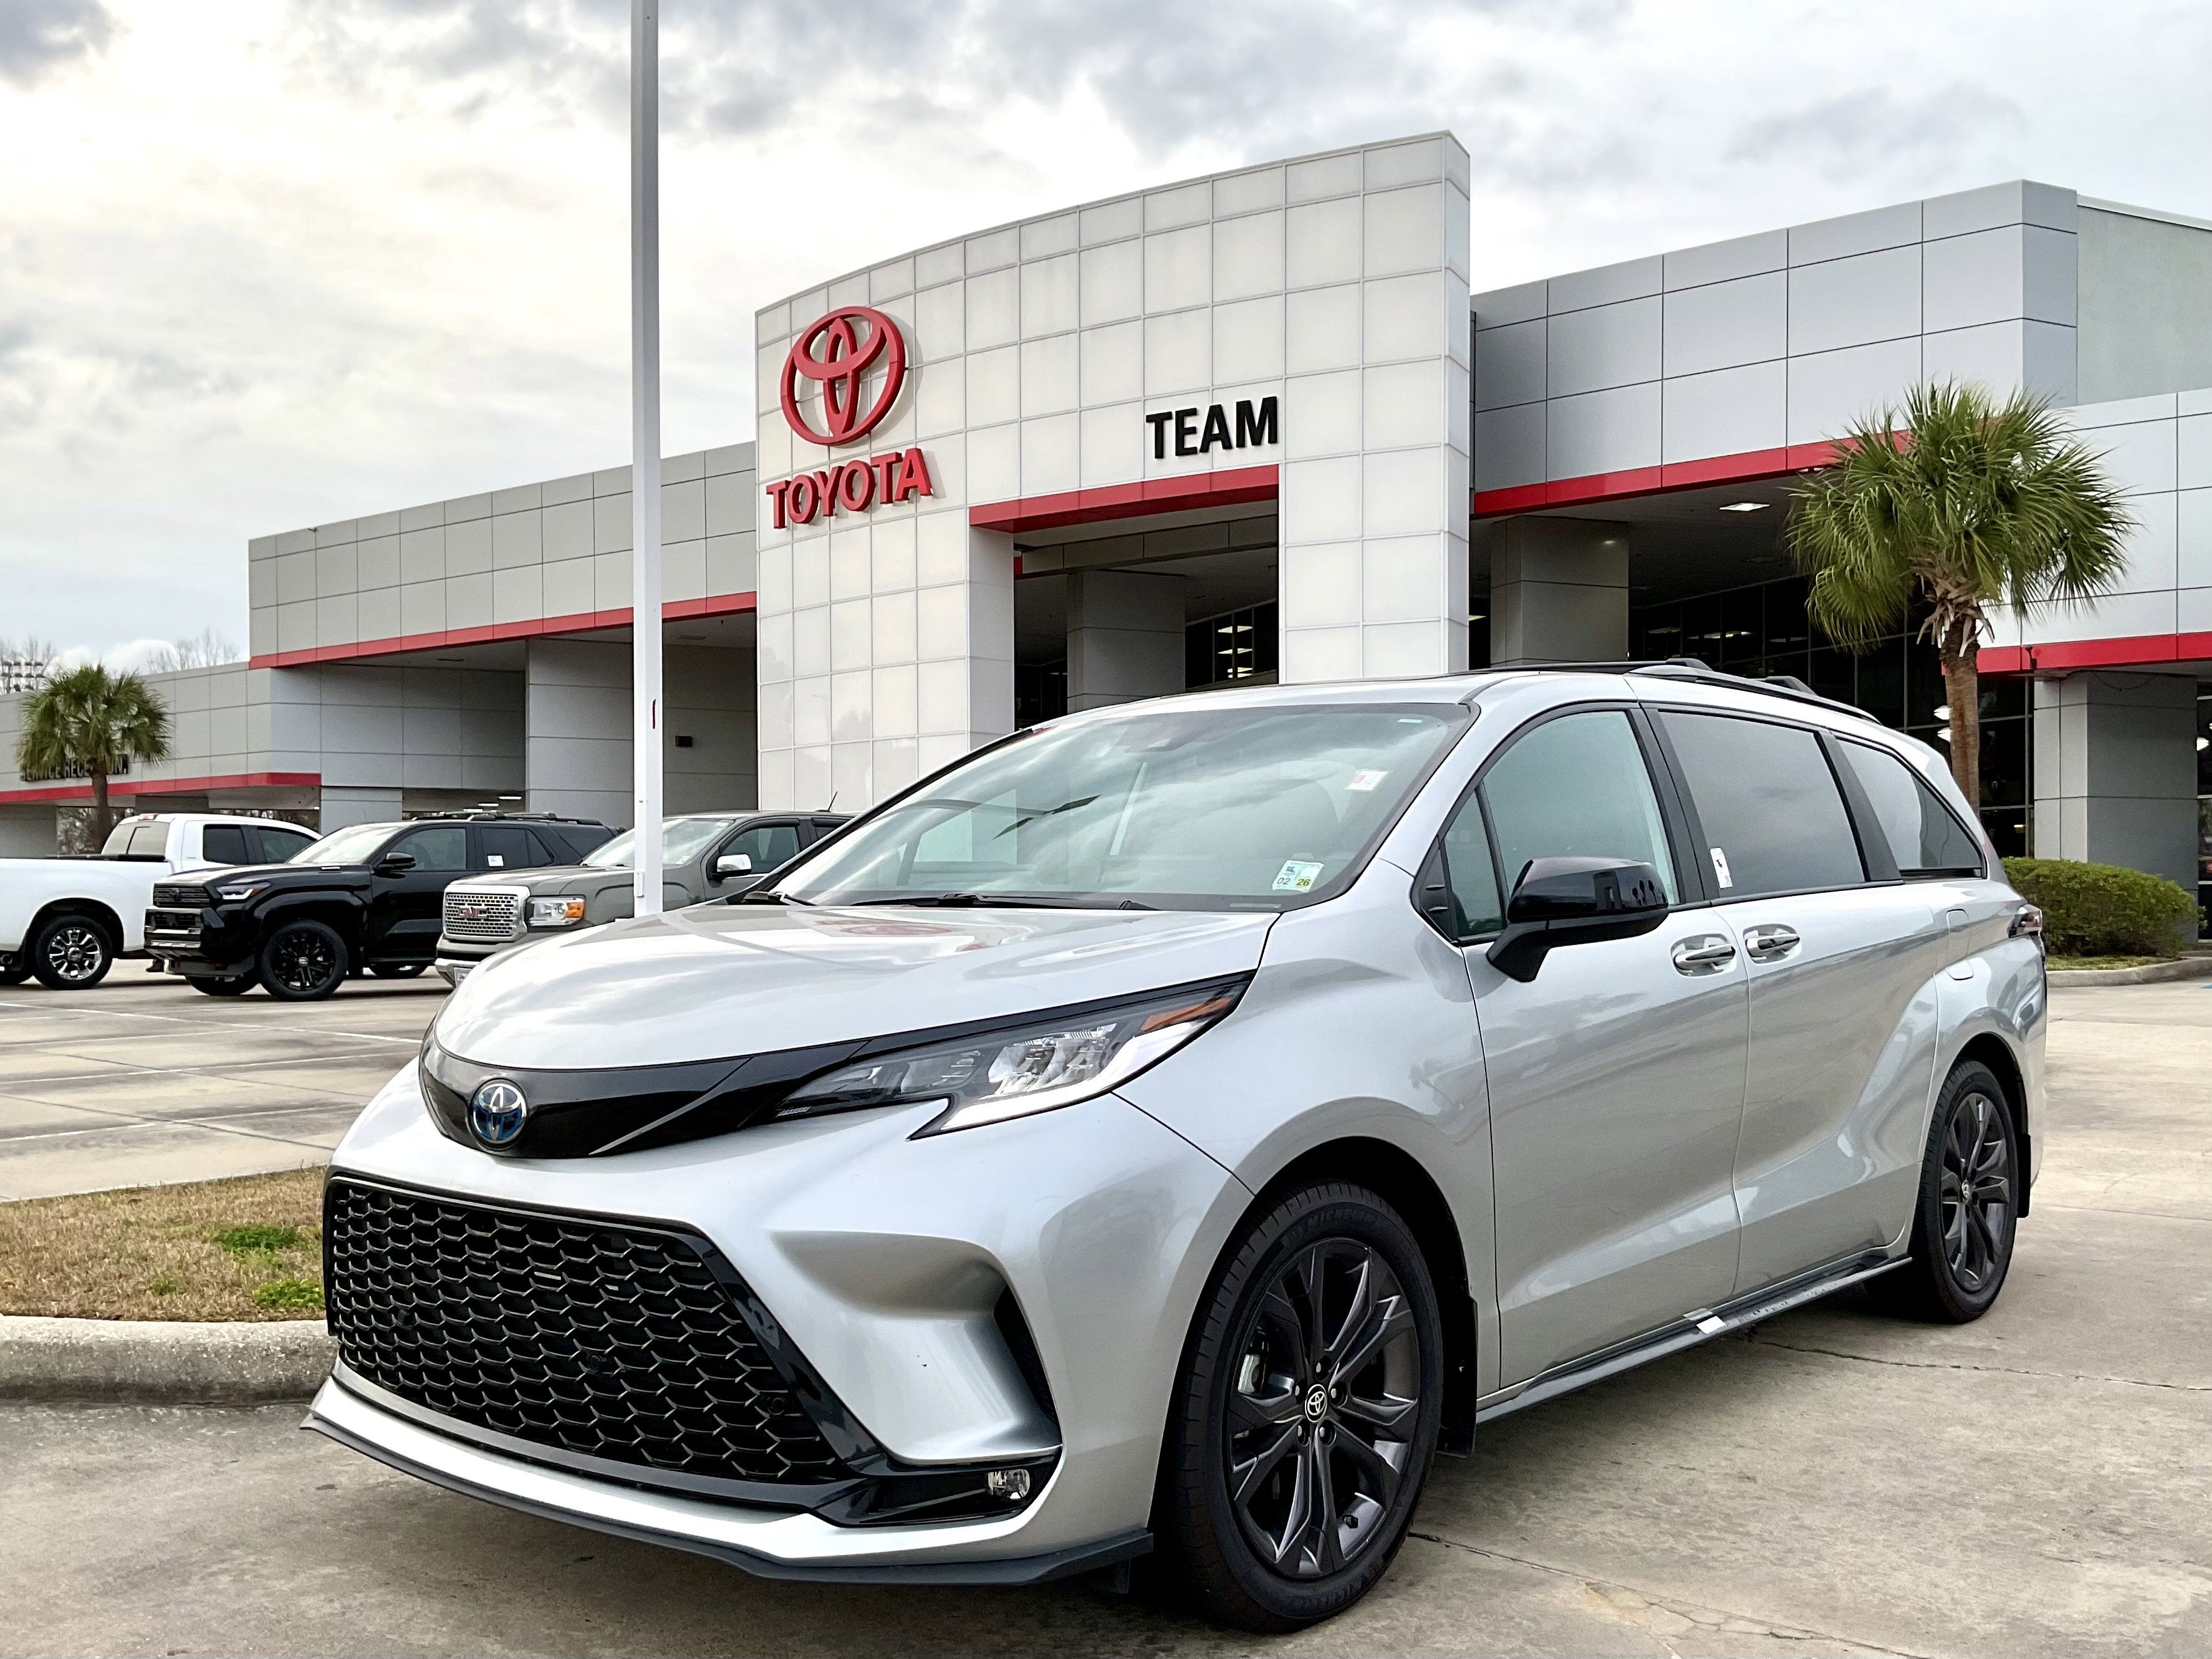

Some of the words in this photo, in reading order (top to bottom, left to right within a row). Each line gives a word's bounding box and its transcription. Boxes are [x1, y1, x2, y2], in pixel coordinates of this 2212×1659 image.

[1146, 396, 1277, 459] TEAM
[766, 448, 933, 529] TOYOTA
[64, 754, 128, 778] RECEON
[458, 906, 489, 919] GMC
